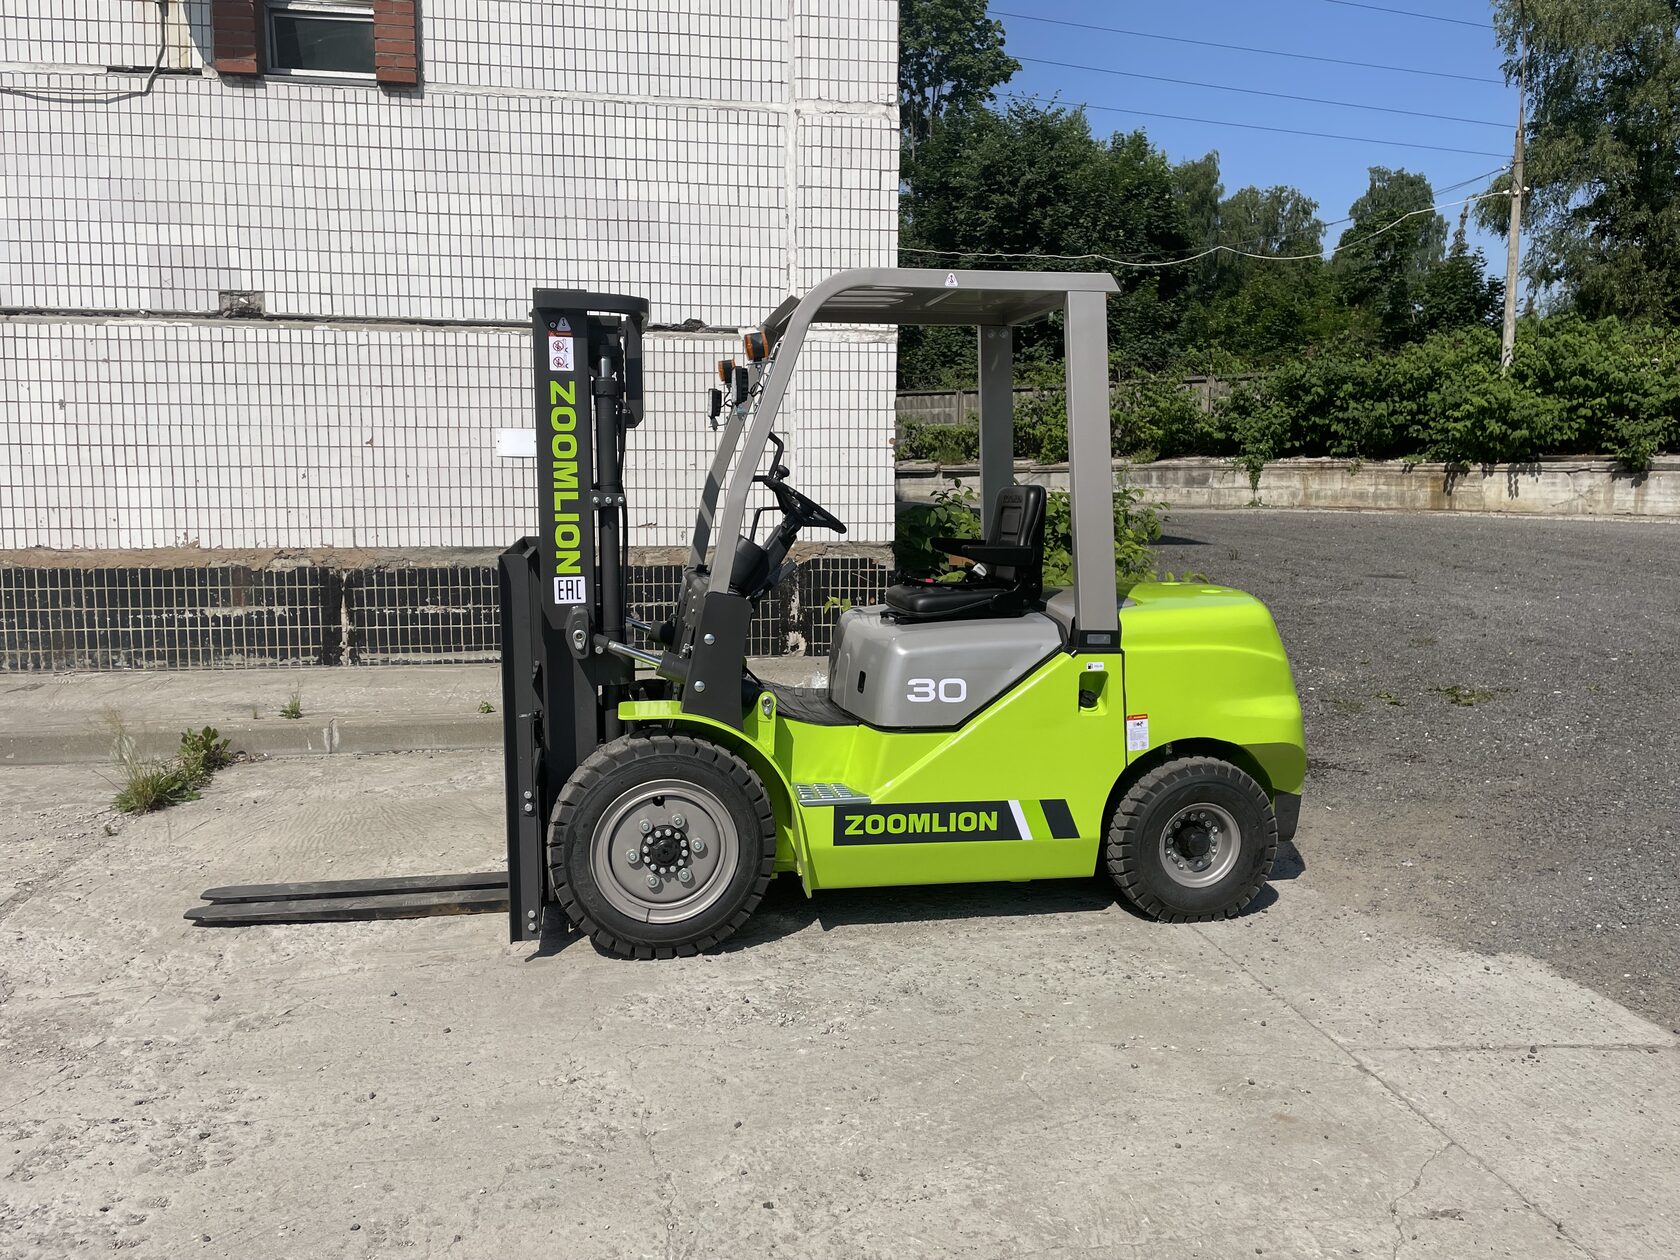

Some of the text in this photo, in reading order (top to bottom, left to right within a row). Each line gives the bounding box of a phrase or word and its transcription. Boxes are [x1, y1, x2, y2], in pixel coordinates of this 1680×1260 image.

[550, 380, 580, 574] ZOOMLION
[558, 578, 582, 600] EAC
[907, 678, 966, 702] 30
[844, 811, 998, 836] ZOOMLION
